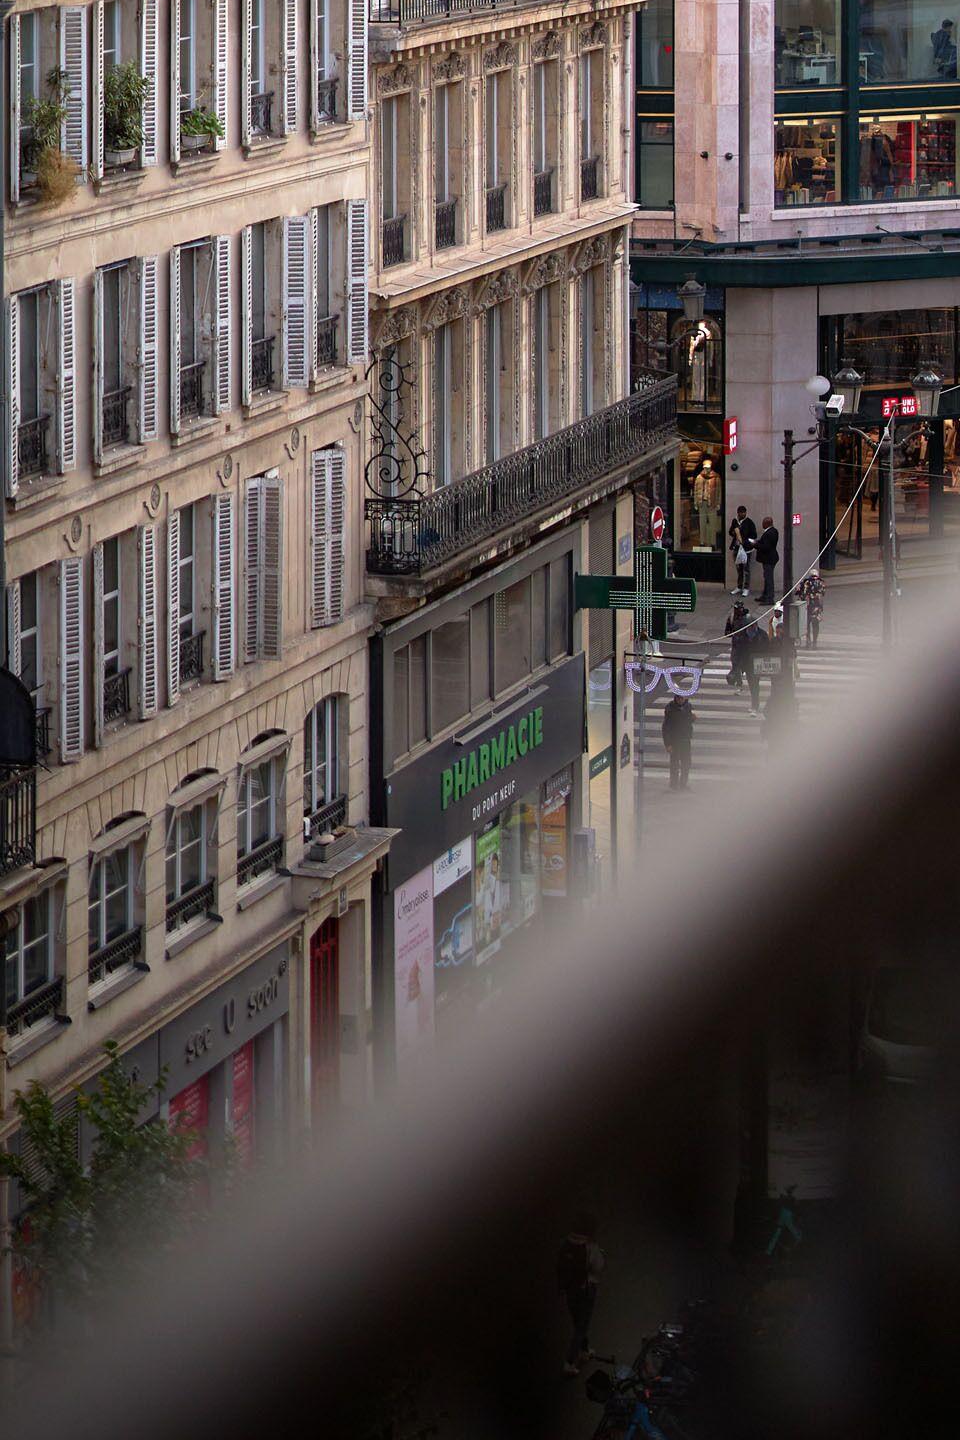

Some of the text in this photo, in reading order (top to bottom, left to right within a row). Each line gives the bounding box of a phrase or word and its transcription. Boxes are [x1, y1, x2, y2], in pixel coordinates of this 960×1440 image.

[902, 398, 914, 406] UNI
[902, 405, 915, 415] QLO
[441, 706, 543, 811] PHARMACIE
[472, 779, 516, 821] DU PONT NEUF
[224, 997, 236, 1035] U
